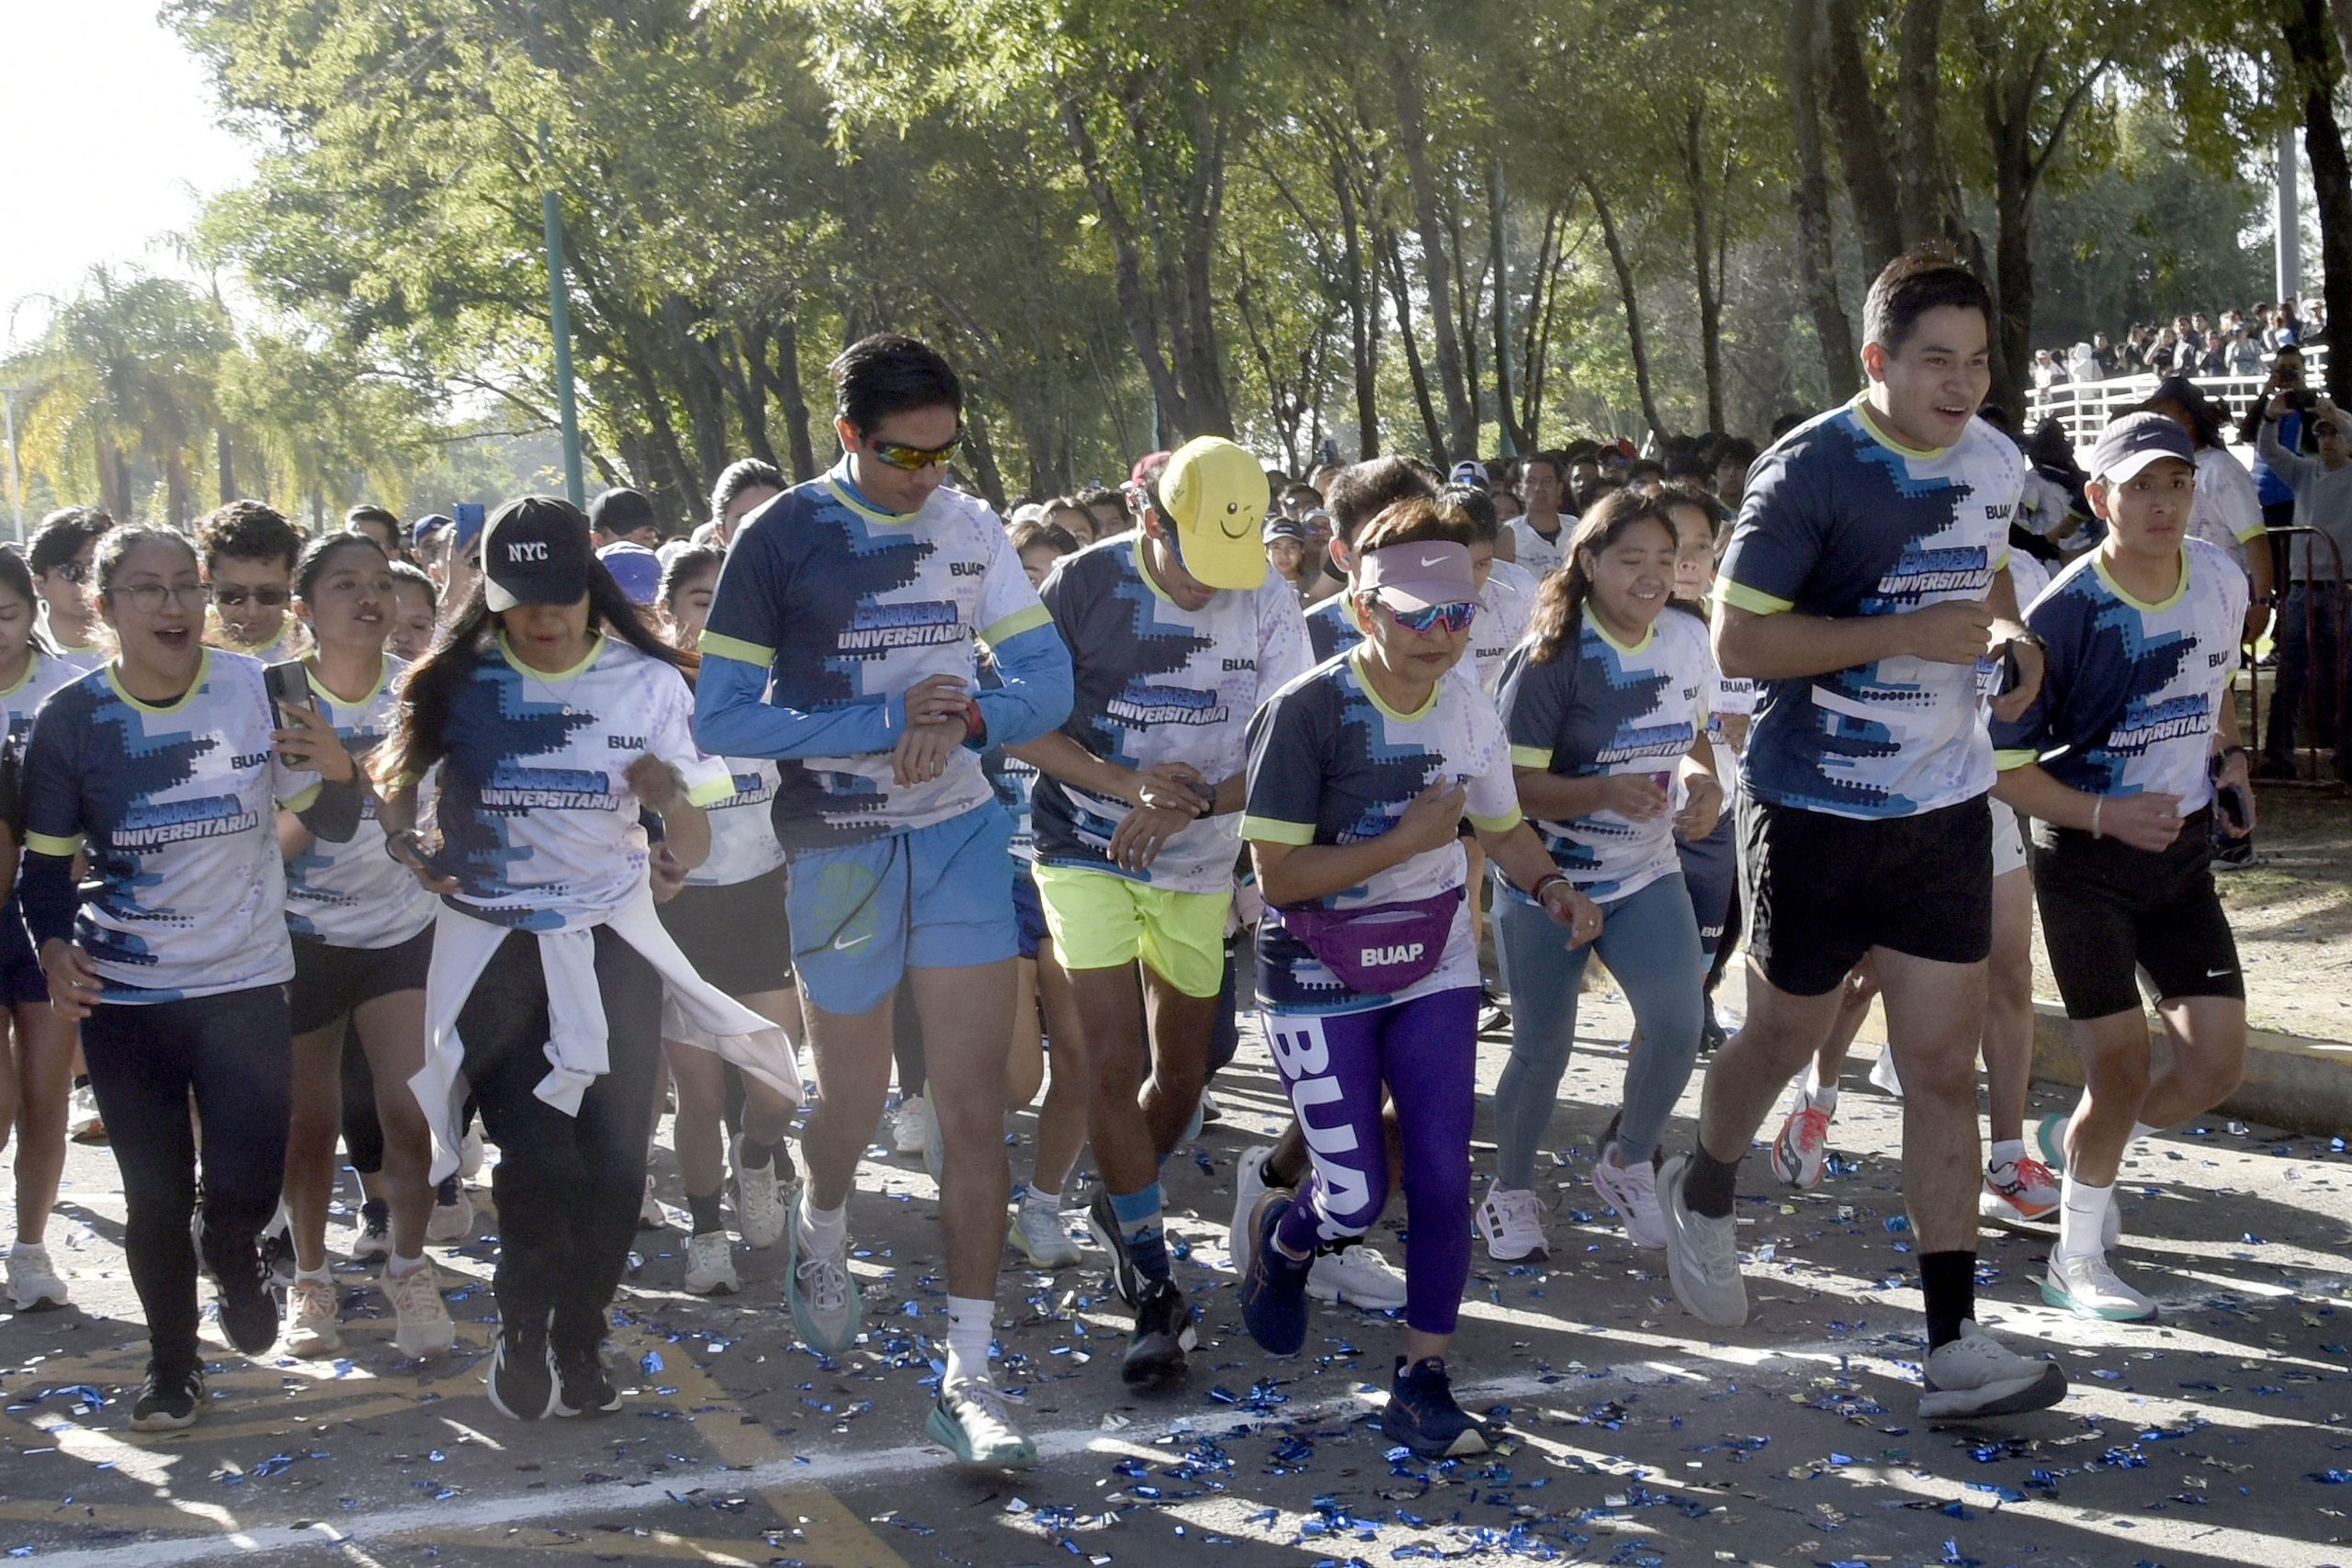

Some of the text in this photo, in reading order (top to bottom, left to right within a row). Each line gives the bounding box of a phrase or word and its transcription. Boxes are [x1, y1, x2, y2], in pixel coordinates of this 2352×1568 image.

[507, 541, 548, 562] NYC
[1898, 546, 1987, 576] CARRERA
[854, 601, 958, 630] CARRERA
[1222, 659, 1257, 671] BUA
[1721, 681, 1752, 694] BUAP
[1106, 700, 1228, 725] UNIVERSITARIA
[608, 736, 647, 750] BUA
[492, 768, 609, 795] CARRERA
[126, 795, 242, 829] CARRERA
[111, 810, 258, 847] UNIVERSITARIA
